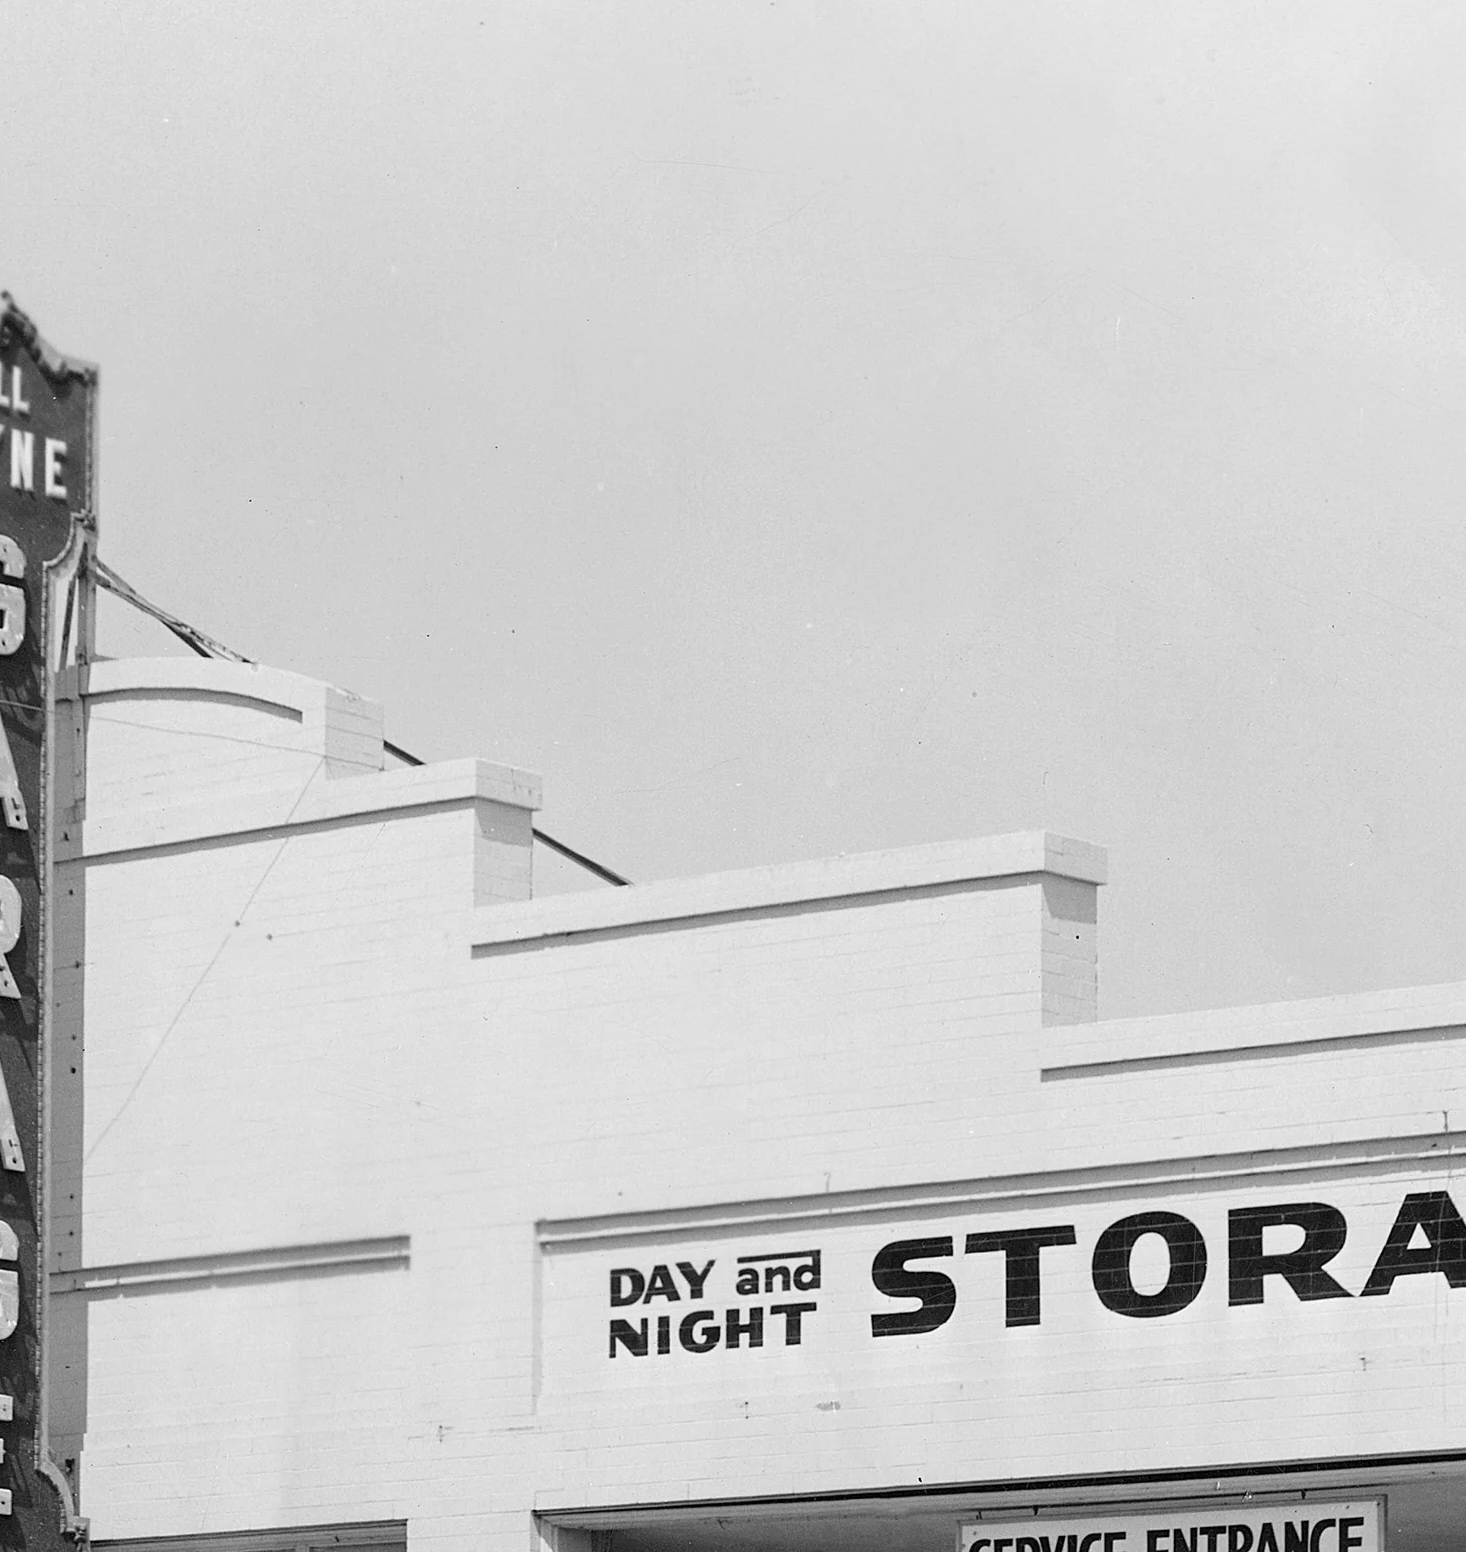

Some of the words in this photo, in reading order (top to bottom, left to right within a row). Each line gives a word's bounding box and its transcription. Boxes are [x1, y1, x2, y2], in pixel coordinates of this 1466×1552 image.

[609, 1259, 716, 1308] DAY
[735, 1249, 822, 1297] and
[609, 1302, 818, 1359] NIGHT
